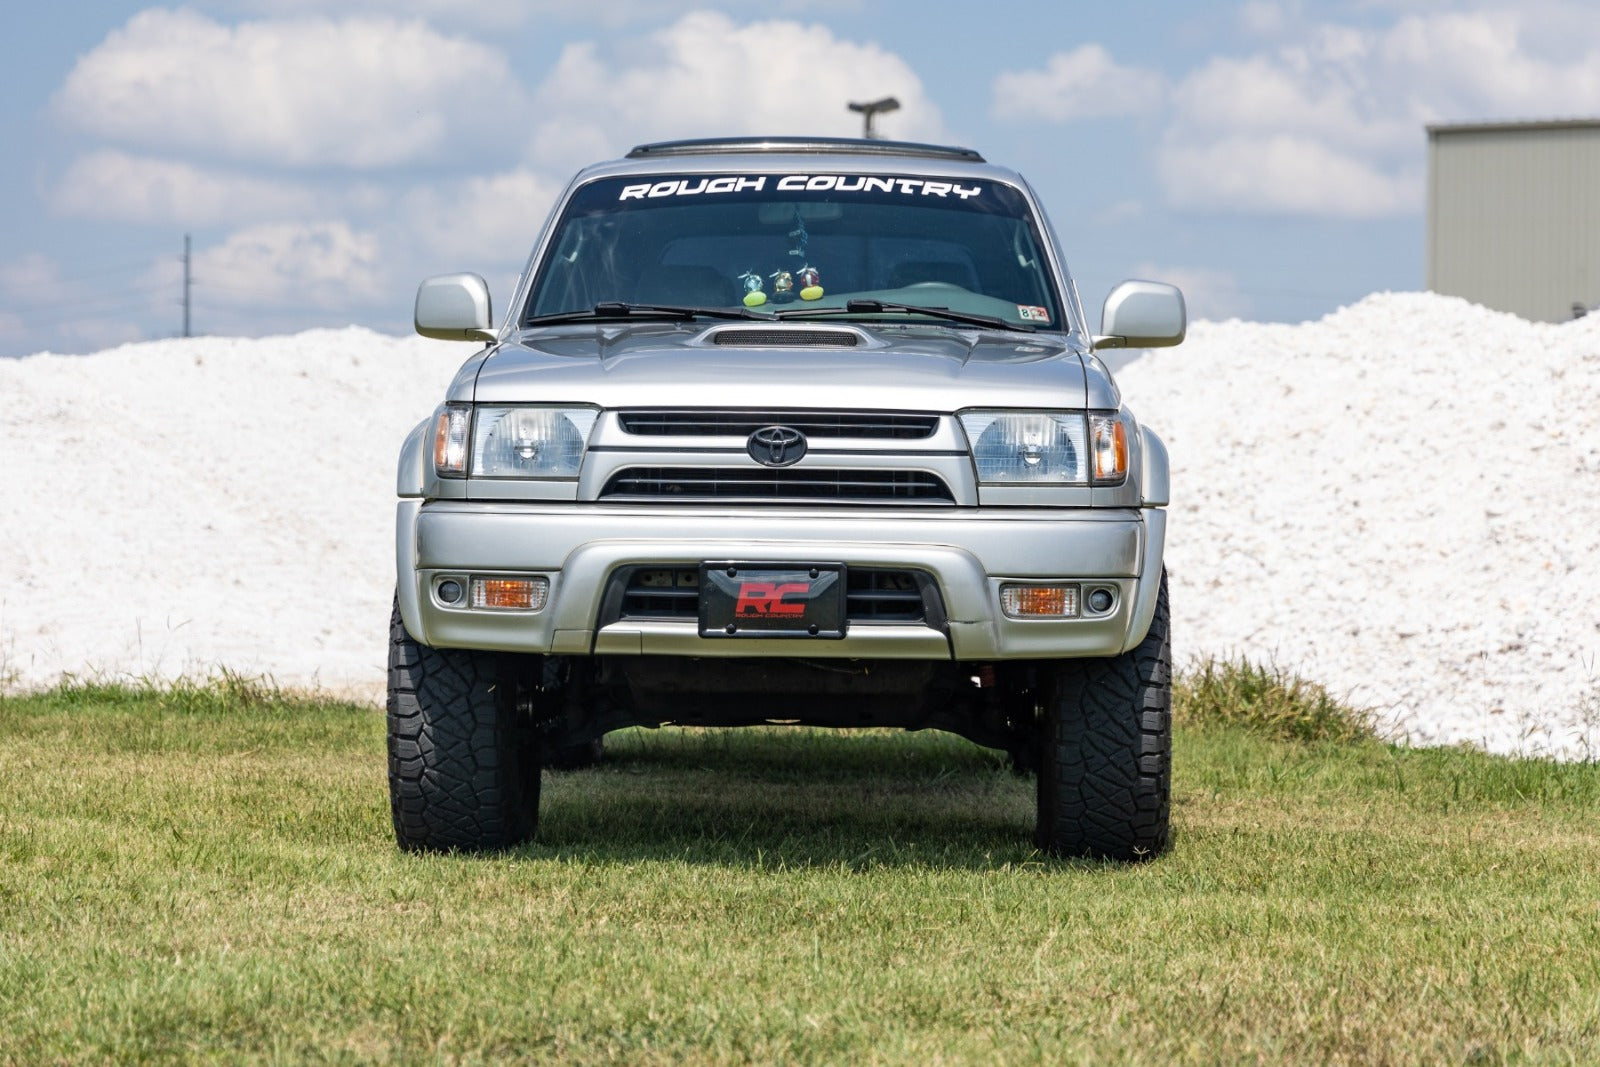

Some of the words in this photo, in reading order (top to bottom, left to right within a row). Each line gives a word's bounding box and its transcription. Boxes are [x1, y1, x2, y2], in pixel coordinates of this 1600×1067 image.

[619, 177, 766, 200] ROUGH
[777, 176, 981, 199] COUNTRY
[1021, 308, 1030, 318] 8
[735, 582, 809, 613] RC
